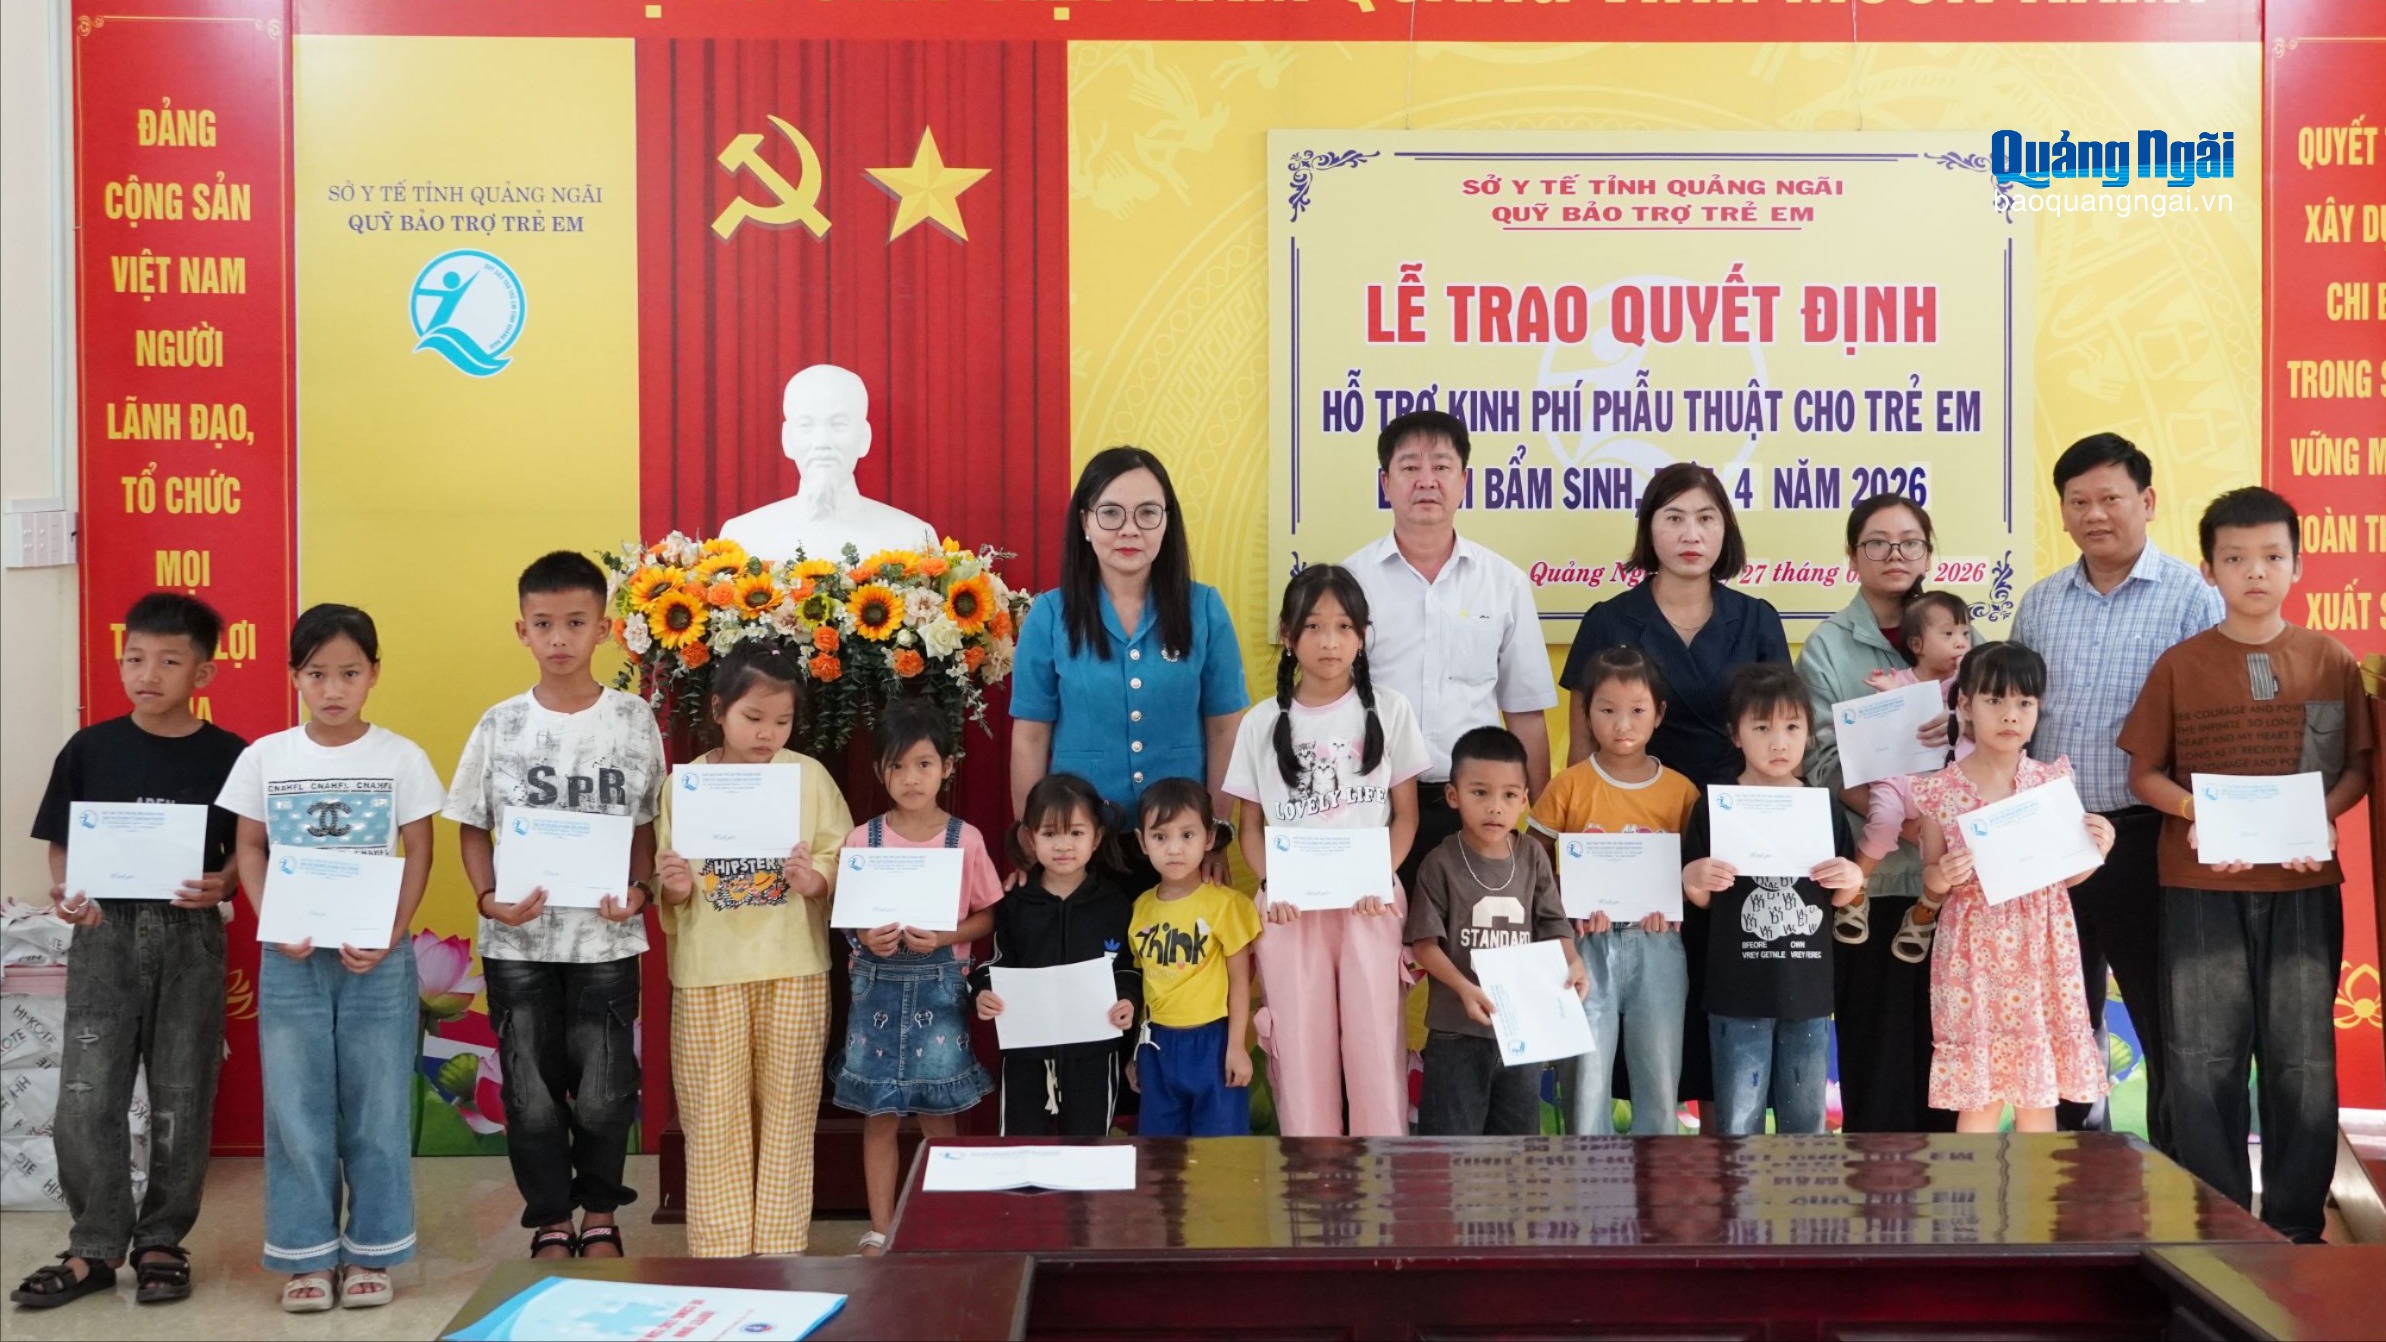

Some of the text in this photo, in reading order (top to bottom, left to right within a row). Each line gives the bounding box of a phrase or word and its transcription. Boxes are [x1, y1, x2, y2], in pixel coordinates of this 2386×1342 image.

[138, 97, 217, 147] ĐẢNG
[2298, 114, 2378, 170] QUYẾT
[105, 170, 251, 228] CỘNG SẢN
[328, 179, 602, 205] SỞ Y TẾ TỈNH QUẢNG NGÃI
[1462, 174, 1844, 198] SỞ Y TẾ TỈNH QUẢNG NGÃI
[348, 208, 584, 236] QUỸ BẢO TRỢ TRẺ EM
[1492, 201, 1814, 226] QUỸ BẢO TRỢ TRẺ EM
[2304, 196, 2355, 243] XÂY
[111, 248, 246, 302] VIỆT NAM
[1367, 263, 1937, 355] LỄ TRAO QUYẾT ĐỊNH
[2326, 282, 2369, 321] CHI
[136, 321, 224, 368] NGƯỜI
[2287, 360, 2372, 399] TRONG
[107, 396, 254, 449] LÃNH ĐẠO,
[1323, 369, 1364, 432] HỖ
[1450, 390, 1520, 432] KINH
[1532, 379, 1584, 432] PHÍ
[1593, 369, 1673, 432] PHẪU
[1683, 379, 1783, 441] THUẬT
[1794, 389, 1855, 432] CHO
[1864, 374, 1922, 432] TRẺ
[1936, 390, 1981, 432] EM
[2290, 430, 2359, 476] VỮNG
[121, 461, 241, 514] TỔ CHỨC
[1484, 445, 1552, 509] BẨM
[1563, 467, 1642, 518] SINH,
[1735, 467, 1753, 508] 4
[1774, 458, 1840, 508] NĂM
[1851, 466, 1927, 508] 2026
[156, 550, 210, 595] MỌI
[1530, 561, 1604, 588] Quảng
[1739, 561, 1766, 585] 27
[1773, 561, 1840, 587] tháng
[1934, 562, 1986, 583] 2026
[2306, 579, 2372, 631] XUẤT
[1274, 786, 1386, 820] LOVELY LIFE
[714, 858, 777, 876] HIPSTER
[1135, 922, 1208, 967] Think
